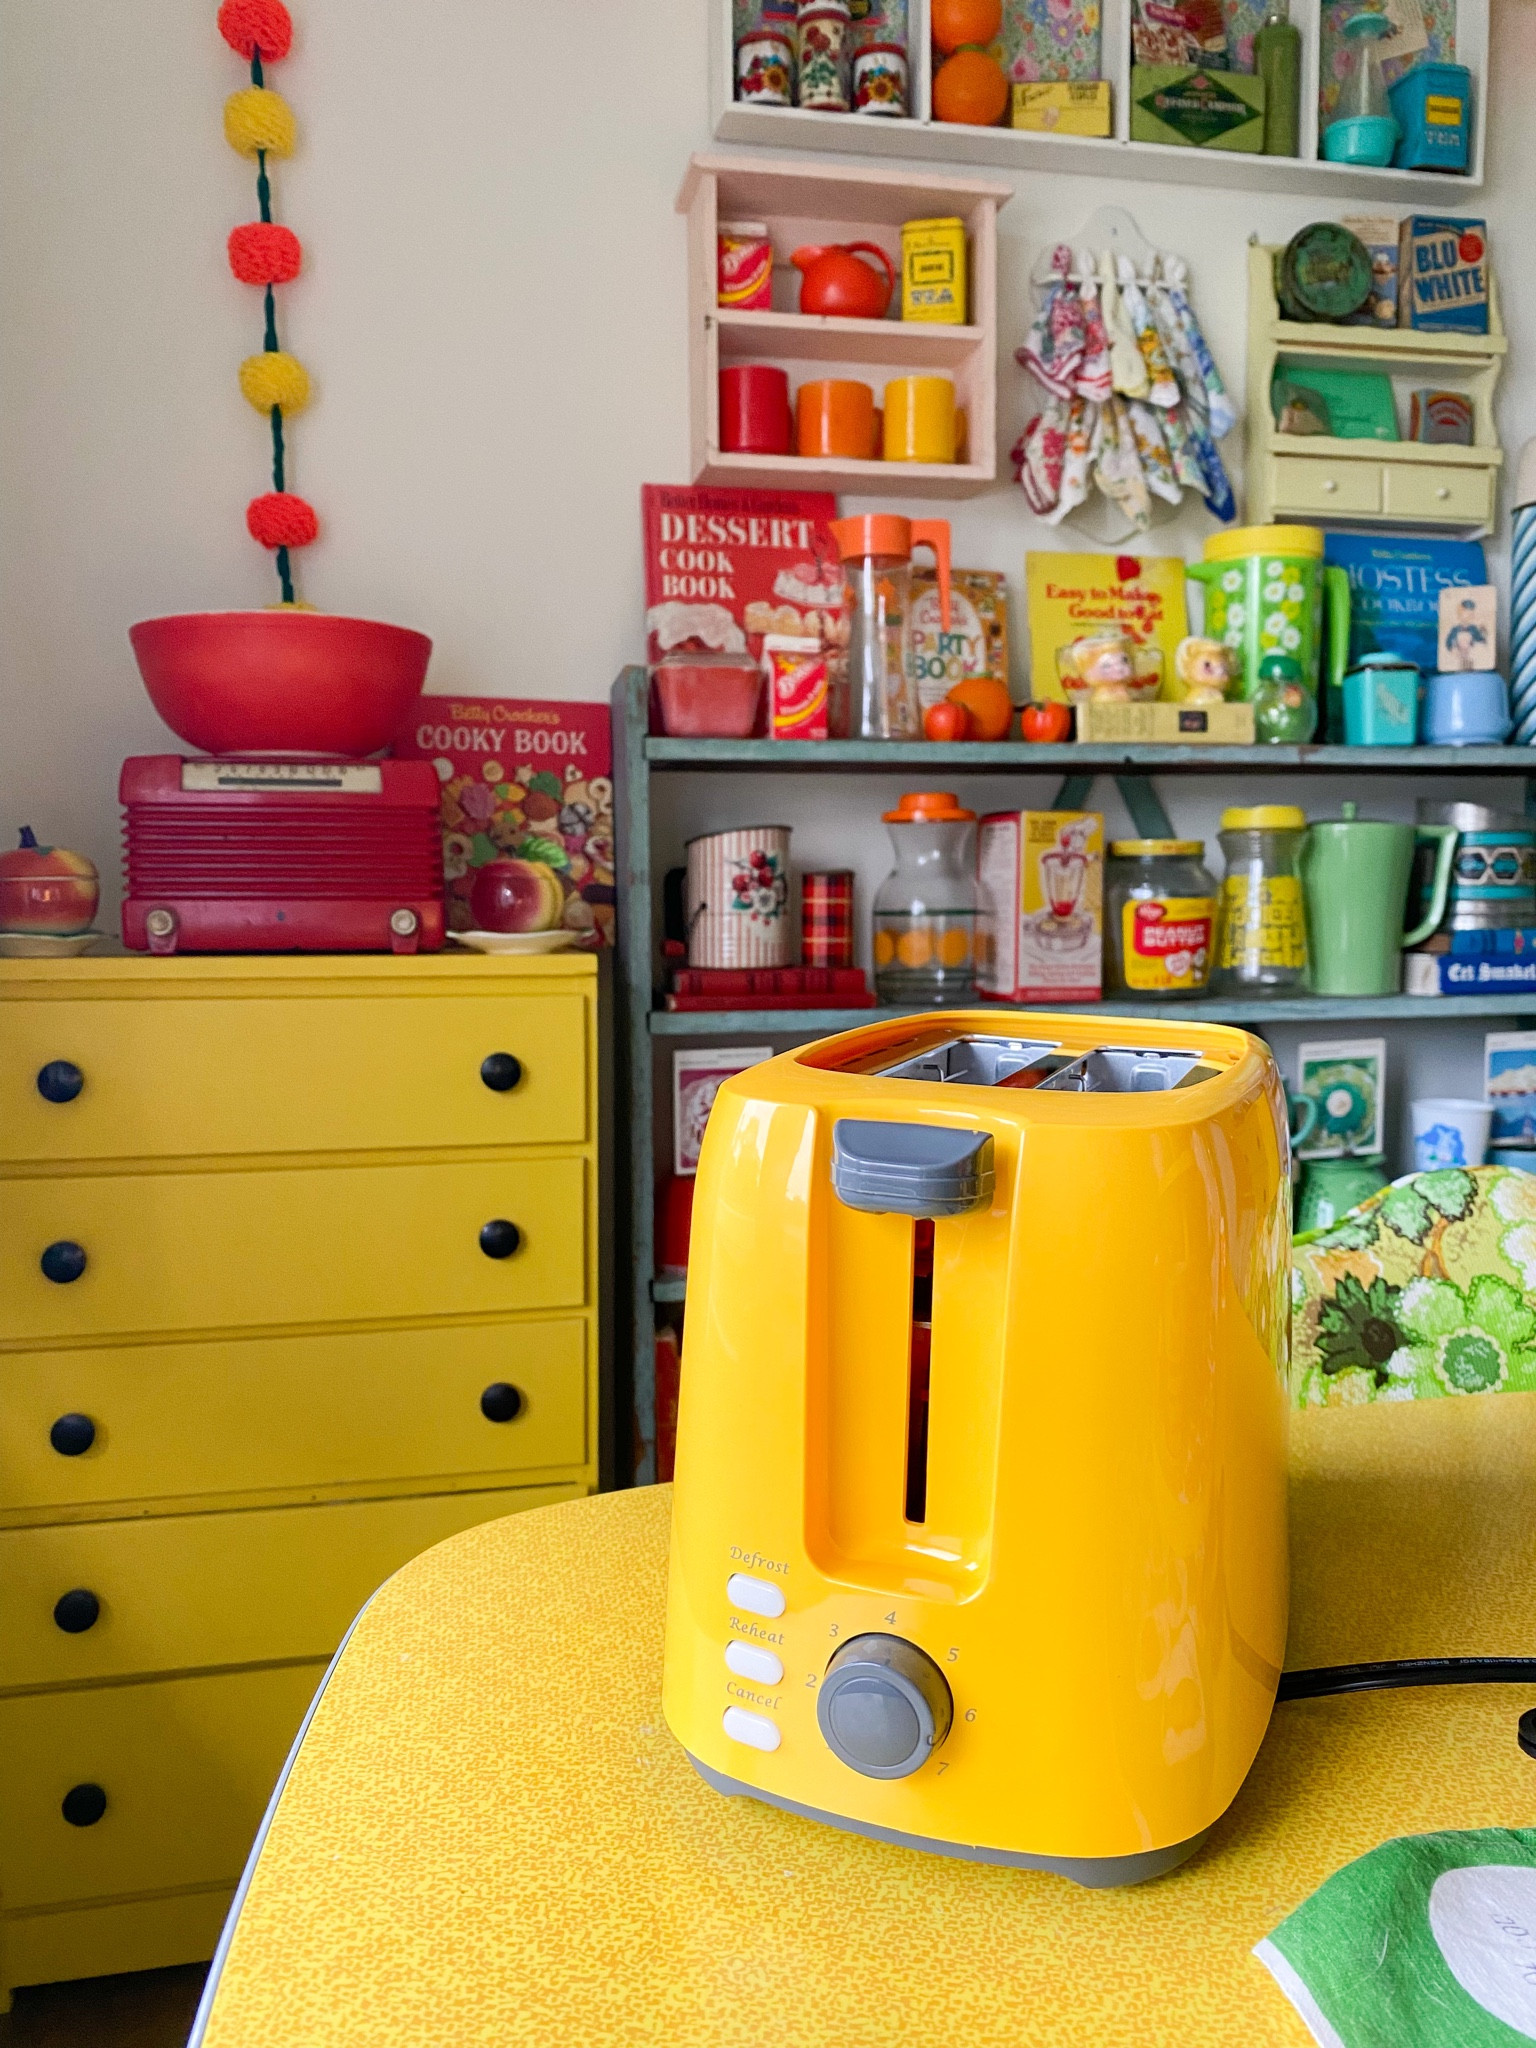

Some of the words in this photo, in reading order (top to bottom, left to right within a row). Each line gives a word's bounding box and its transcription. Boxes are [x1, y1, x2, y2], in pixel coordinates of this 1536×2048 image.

[1415, 240, 1457, 273] BLU
[1415, 266, 1484, 302] WHITE
[911, 288, 954, 306] TEA
[660, 512, 815, 549] DESSERT
[659, 548, 735, 574] COOK
[661, 574, 737, 599] BOOK
[416, 724, 505, 752] COOKY
[514, 728, 588, 756] BOOK
[1143, 924, 1205, 938] PEANUT
[730, 1546, 790, 1575] Defrost
[884, 1610, 898, 1625] 4
[730, 1616, 785, 1646] Reheat
[829, 1624, 840, 1638] 3
[947, 1647, 961, 1662] 5
[805, 1673, 818, 1688] 2
[726, 1681, 783, 1709] Cancel
[965, 1708, 977, 1722] 6
[937, 1761, 950, 1777] 7
